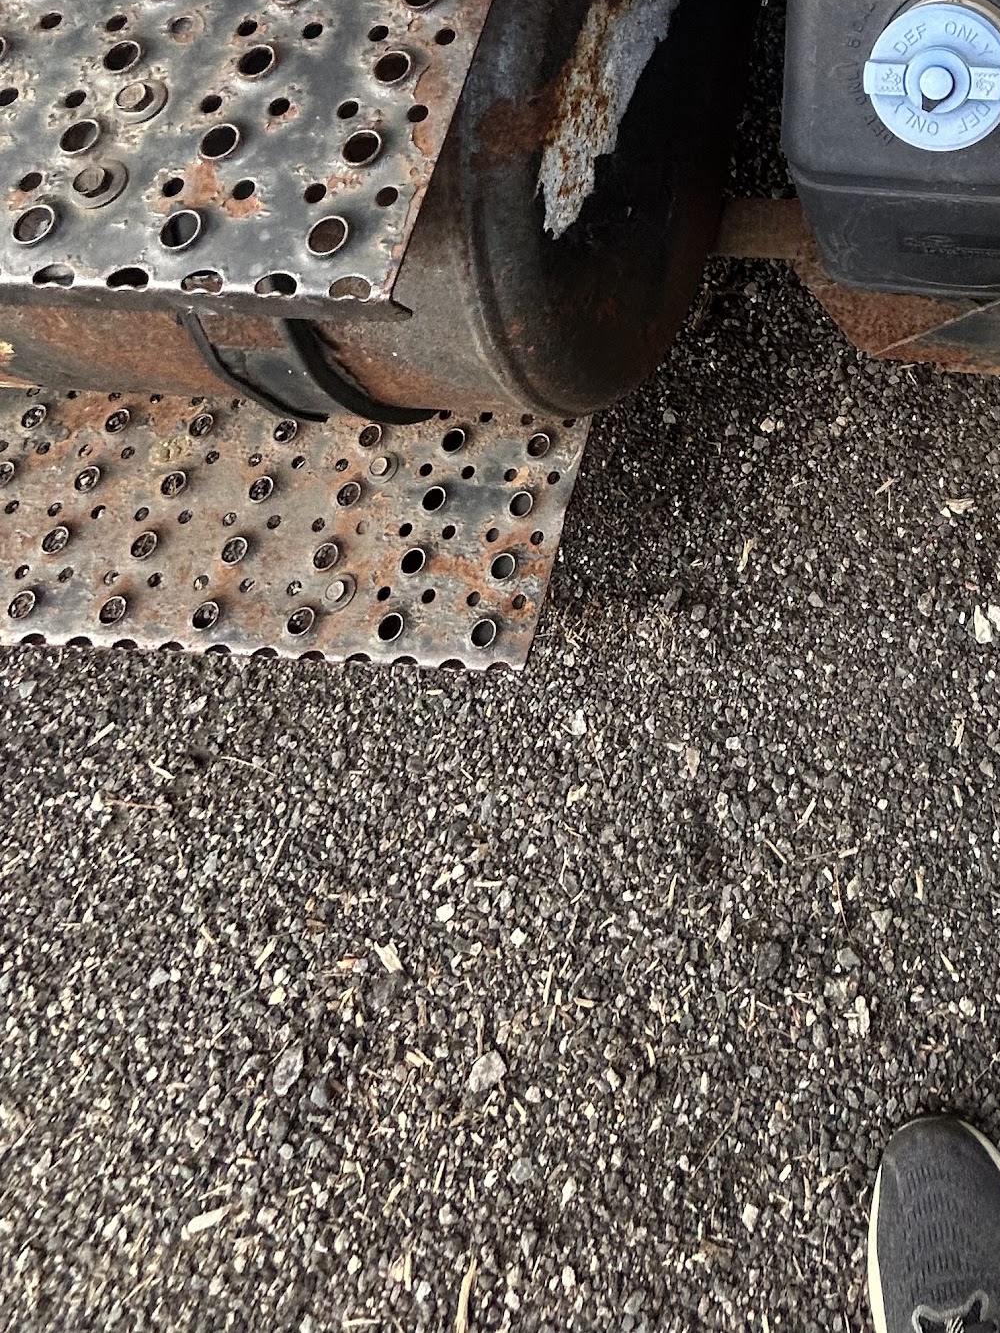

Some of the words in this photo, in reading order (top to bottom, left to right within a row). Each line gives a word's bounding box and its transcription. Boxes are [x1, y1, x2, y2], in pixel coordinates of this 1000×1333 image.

[893, 23, 927, 56] DEF
[944, 21, 994, 56] ONLY
[958, 101, 991, 134] DEF
